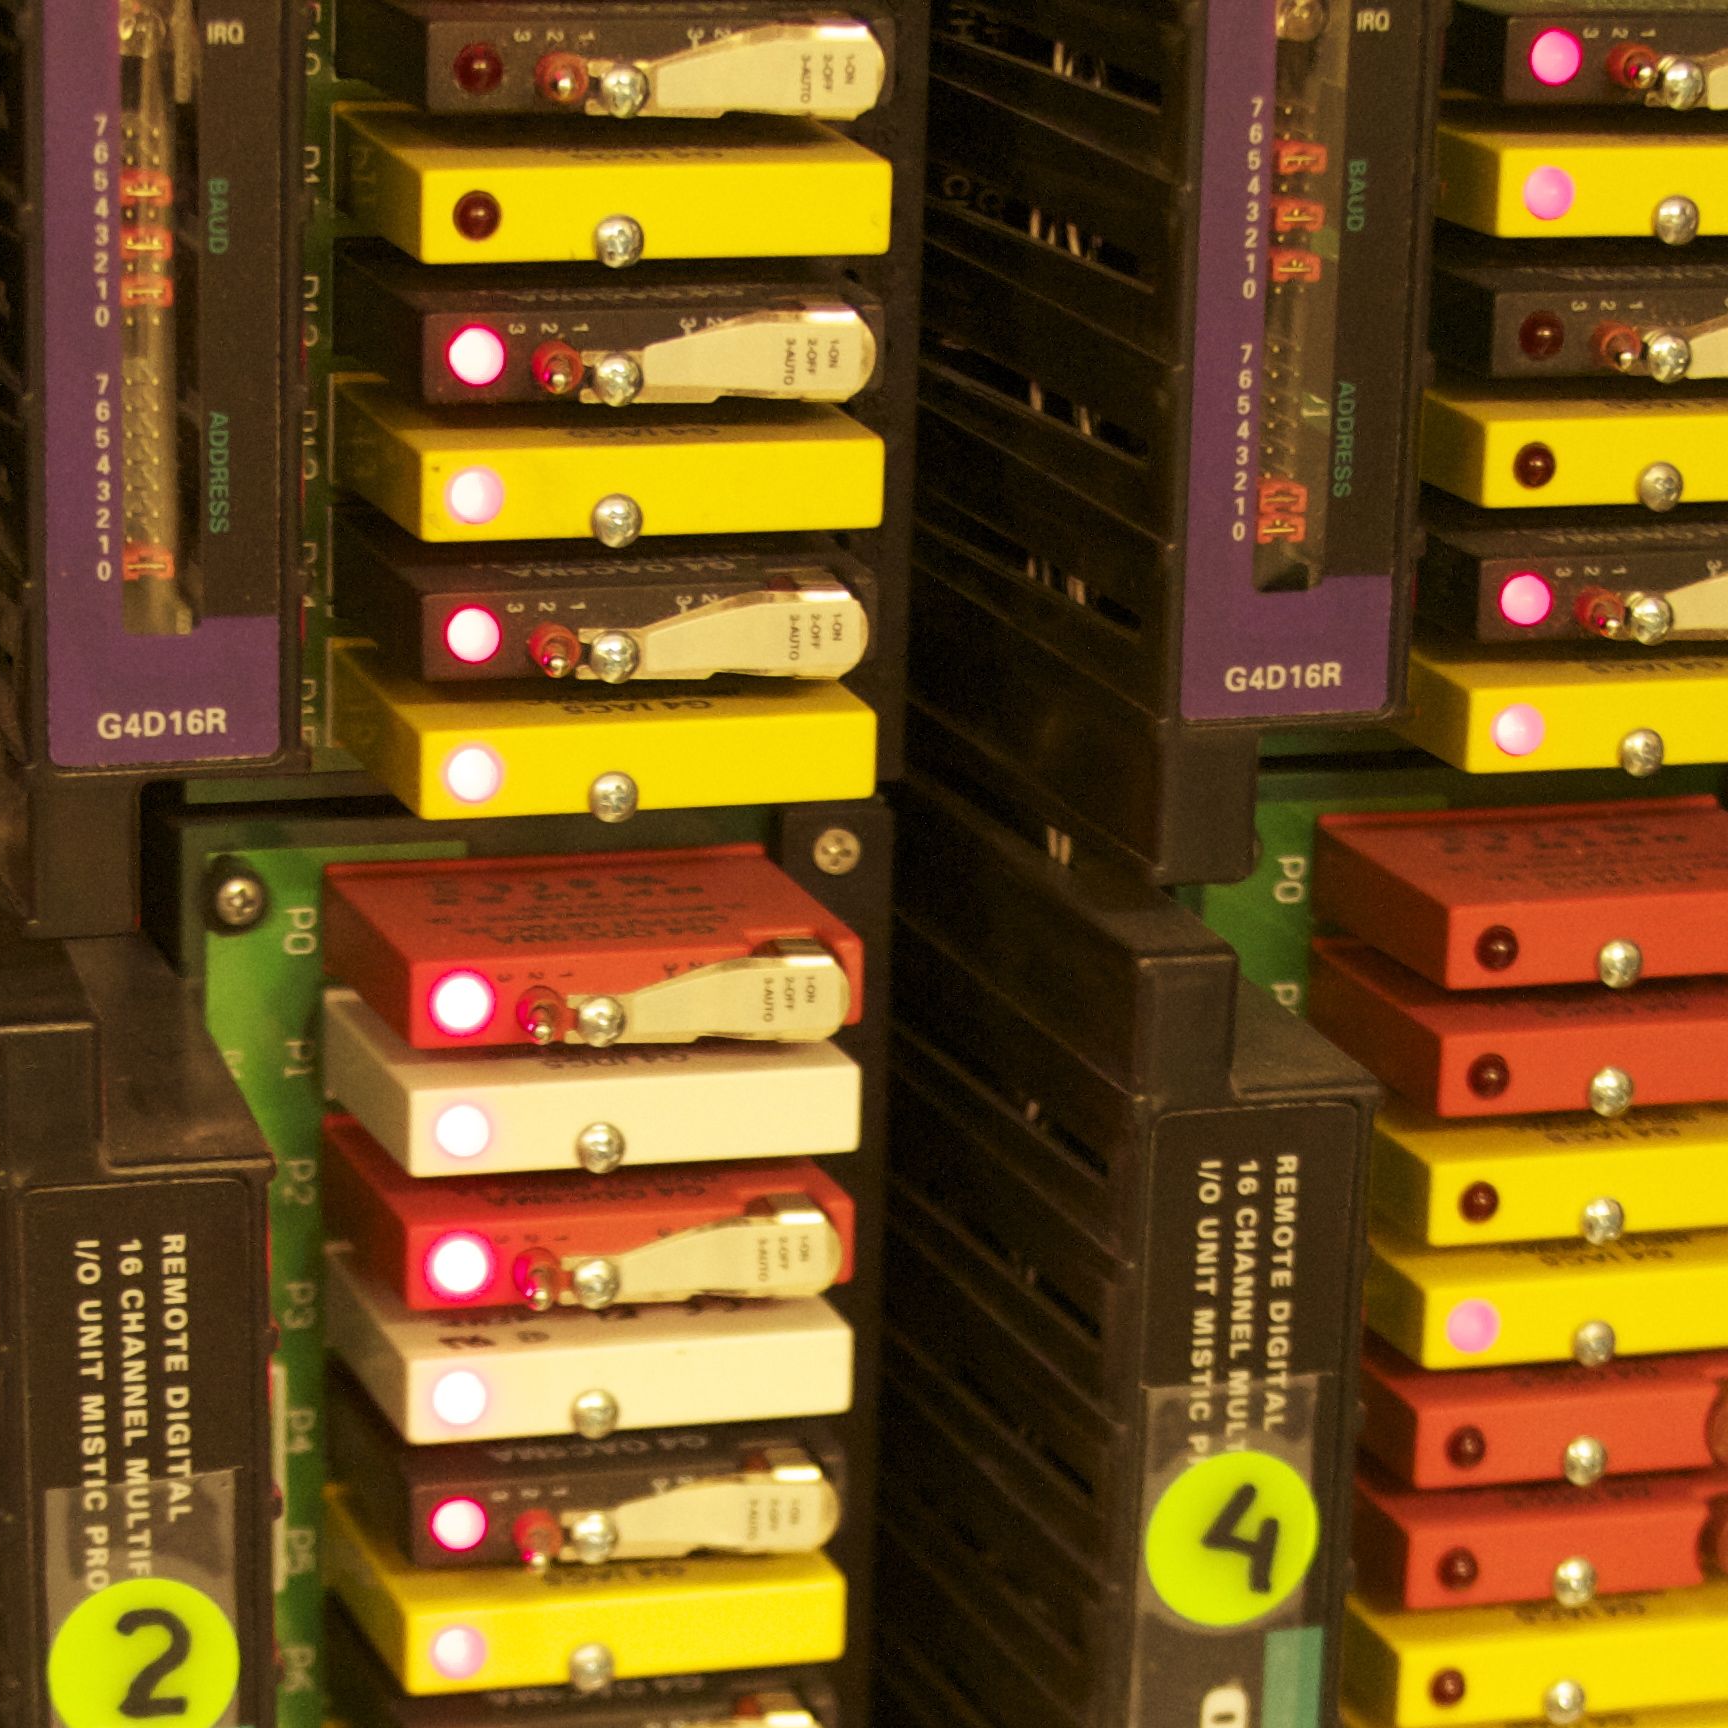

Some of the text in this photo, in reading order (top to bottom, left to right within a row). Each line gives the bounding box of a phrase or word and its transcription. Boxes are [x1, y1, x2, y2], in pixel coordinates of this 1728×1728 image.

[207, 22, 244, 45] IRQ
[1357, 10, 1391, 32] IRQ
[800, 54, 812, 104] 3-AUTO
[822, 53, 834, 92] 2-OFF
[844, 53, 855, 86] 1-ON
[208, 178, 229, 254] BAUD
[1347, 160, 1367, 232] BAUD
[784, 338, 796, 386] 3-AUTO
[806, 338, 818, 376] 2-OFF
[828, 339, 840, 368] 1-ON
[1333, 381, 1355, 498] ADDRESS
[208, 411, 230, 534] ADDRESS
[788, 614, 800, 661] 3-AUTO
[810, 614, 821, 650] 2-OFF
[832, 614, 843, 642] 1-ON
[1225, 663, 1342, 692] G4D16R
[97, 707, 228, 740] G4D16R
[1274, 855, 1306, 904] P0
[283, 905, 316, 956] P0
[284, 1040, 314, 1077] P1
[282, 1158, 314, 1205] P2
[1227, 1161, 1259, 1361] 16 CHANNEL
[284, 1282, 315, 1329] P3
[1189, 1159, 1223, 1422] I/O UNIT MISTIC
[1263, 1154, 1299, 1432] REMOTE DIGITAL
[116, 1239, 149, 1449] 16 CHANNEL
[75, 1239, 109, 1513] I/O UNIT MISTIC
[161, 1233, 194, 1524] REMOTE DIGITAL
[1201, 1482, 1279, 1595] 4
[115, 1607, 191, 1717] 2
